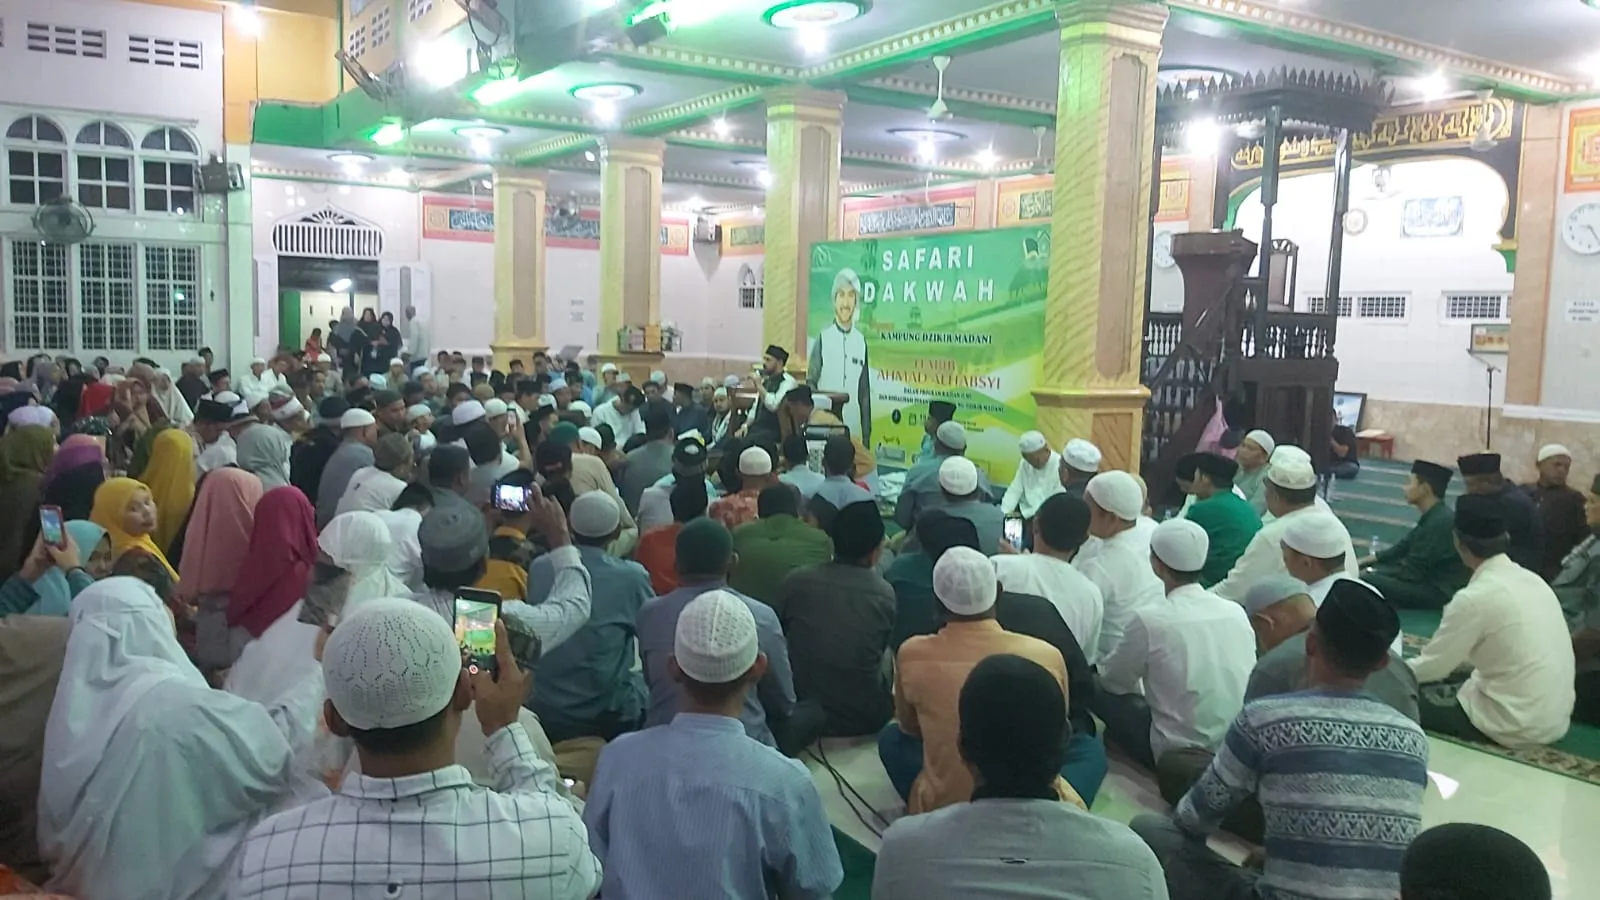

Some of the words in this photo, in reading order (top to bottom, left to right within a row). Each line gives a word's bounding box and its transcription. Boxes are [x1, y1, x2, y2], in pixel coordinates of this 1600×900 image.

[882, 245, 974, 271] SAFARI
[863, 279, 994, 304] DAKWAH
[881, 332, 920, 342] KAMPUNG
[922, 333, 952, 344] DZIKIR
[954, 334, 992, 345] MADANI
[877, 369, 927, 383] AHMAD
